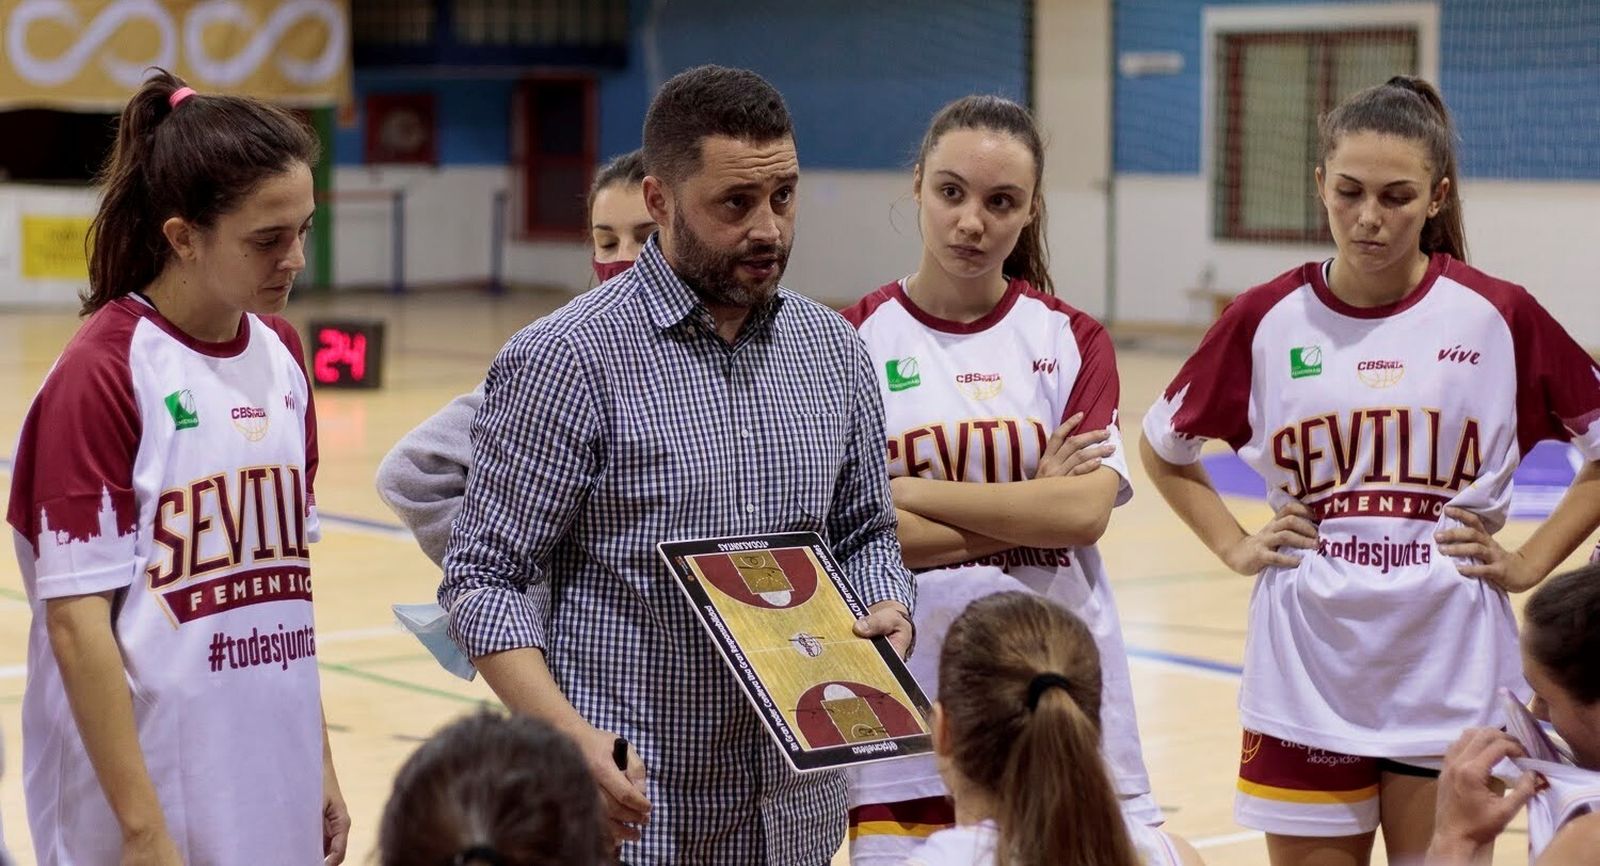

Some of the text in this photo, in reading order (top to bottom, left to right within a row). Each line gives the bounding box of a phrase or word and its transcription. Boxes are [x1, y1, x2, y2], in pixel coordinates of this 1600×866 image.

[314, 328, 366, 382] 24
[1270, 407, 1483, 499] SEVILLA
[1323, 495, 1443, 517] MENINO
[147, 464, 309, 590] SEVILL
[830, 571, 856, 605] Fernando
[208, 623, 316, 672] #todasjunta
[734, 652, 749, 669] Gran
[768, 707, 785, 727] Poder
[780, 725, 794, 743] Gran
